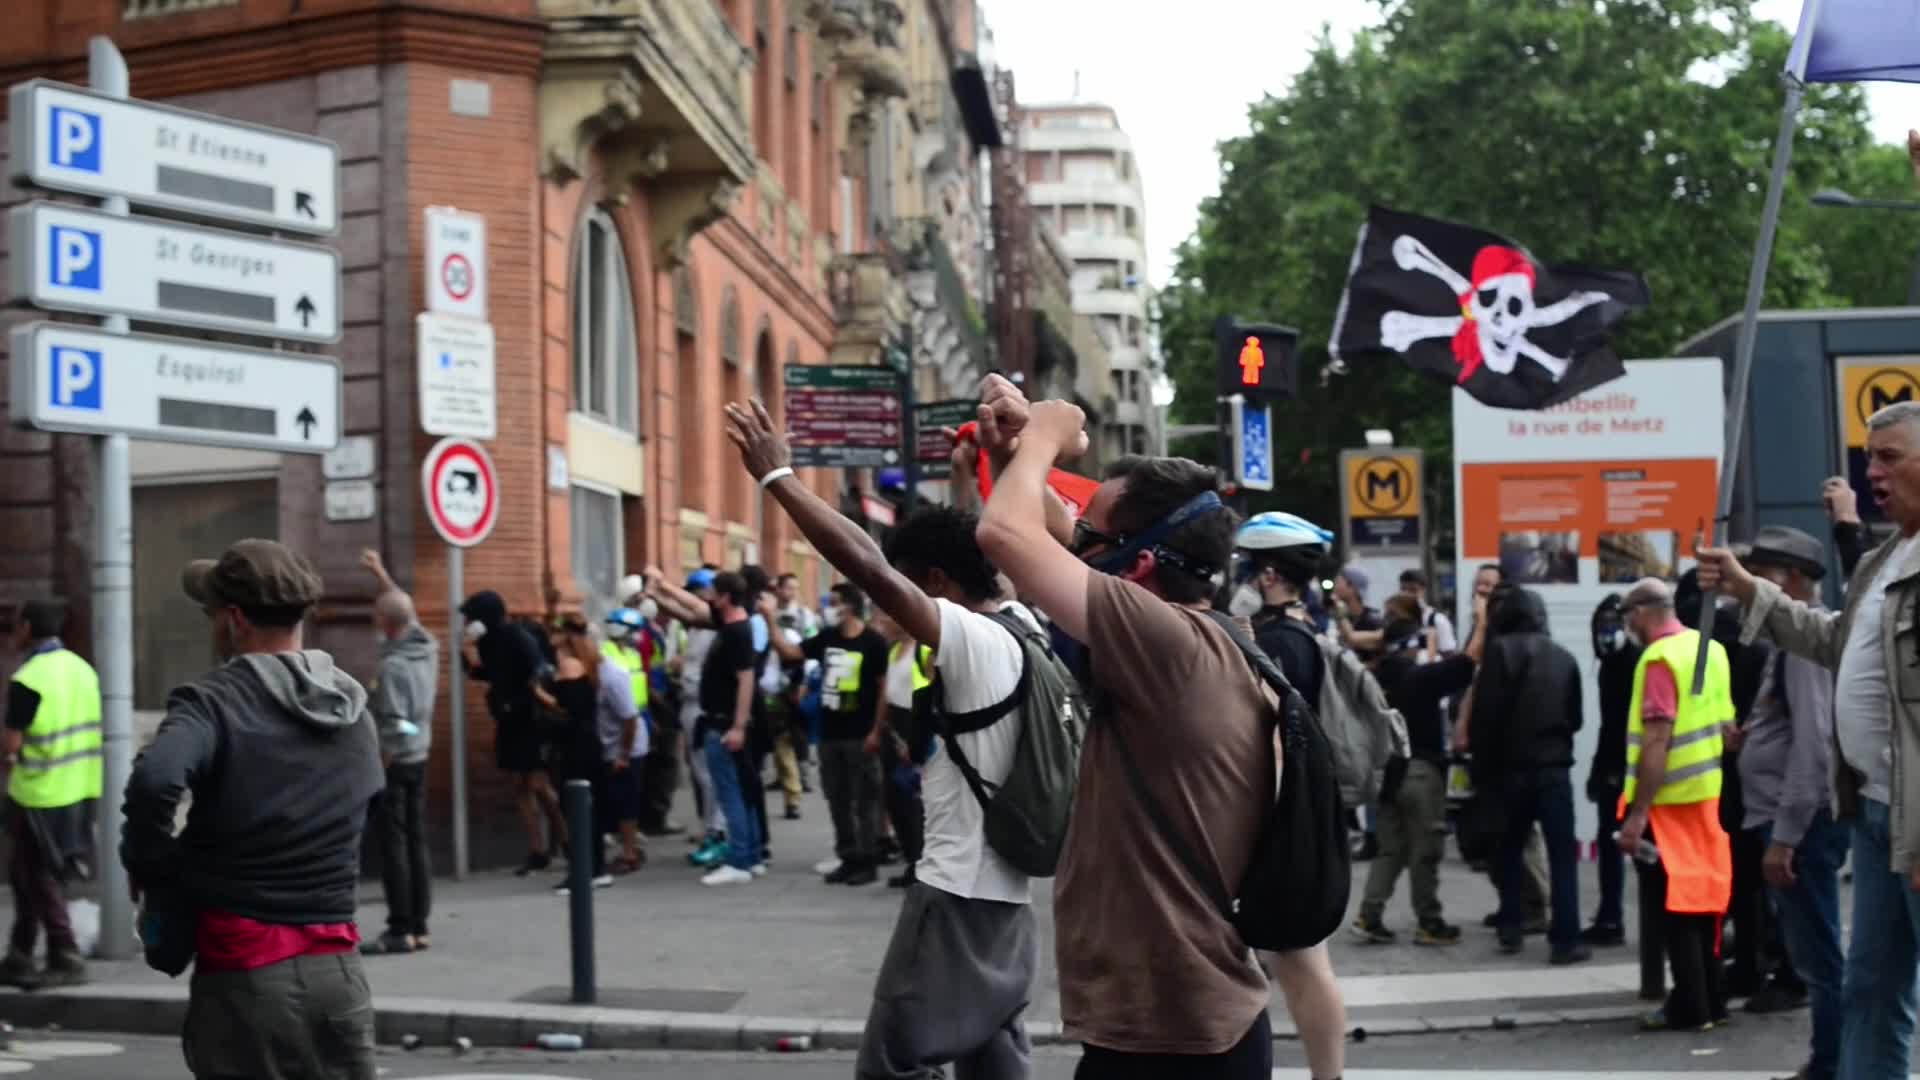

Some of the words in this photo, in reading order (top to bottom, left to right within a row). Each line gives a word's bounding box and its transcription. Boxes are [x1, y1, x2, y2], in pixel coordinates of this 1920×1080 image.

[61, 111, 94, 166] P
[156, 126, 178, 150] St
[189, 132, 267, 167] Etienne
[61, 229, 94, 285] P
[156, 238, 178, 260] St
[191, 242, 275, 277] Georges
[62, 351, 94, 405] P
[156, 353, 246, 384] Esquirol
[1508, 418, 1527, 436] la
[1533, 422, 1569, 435] rue
[1576, 417, 1604, 434] de
[1610, 417, 1664, 433] Metz
[1366, 470, 1401, 501] M
